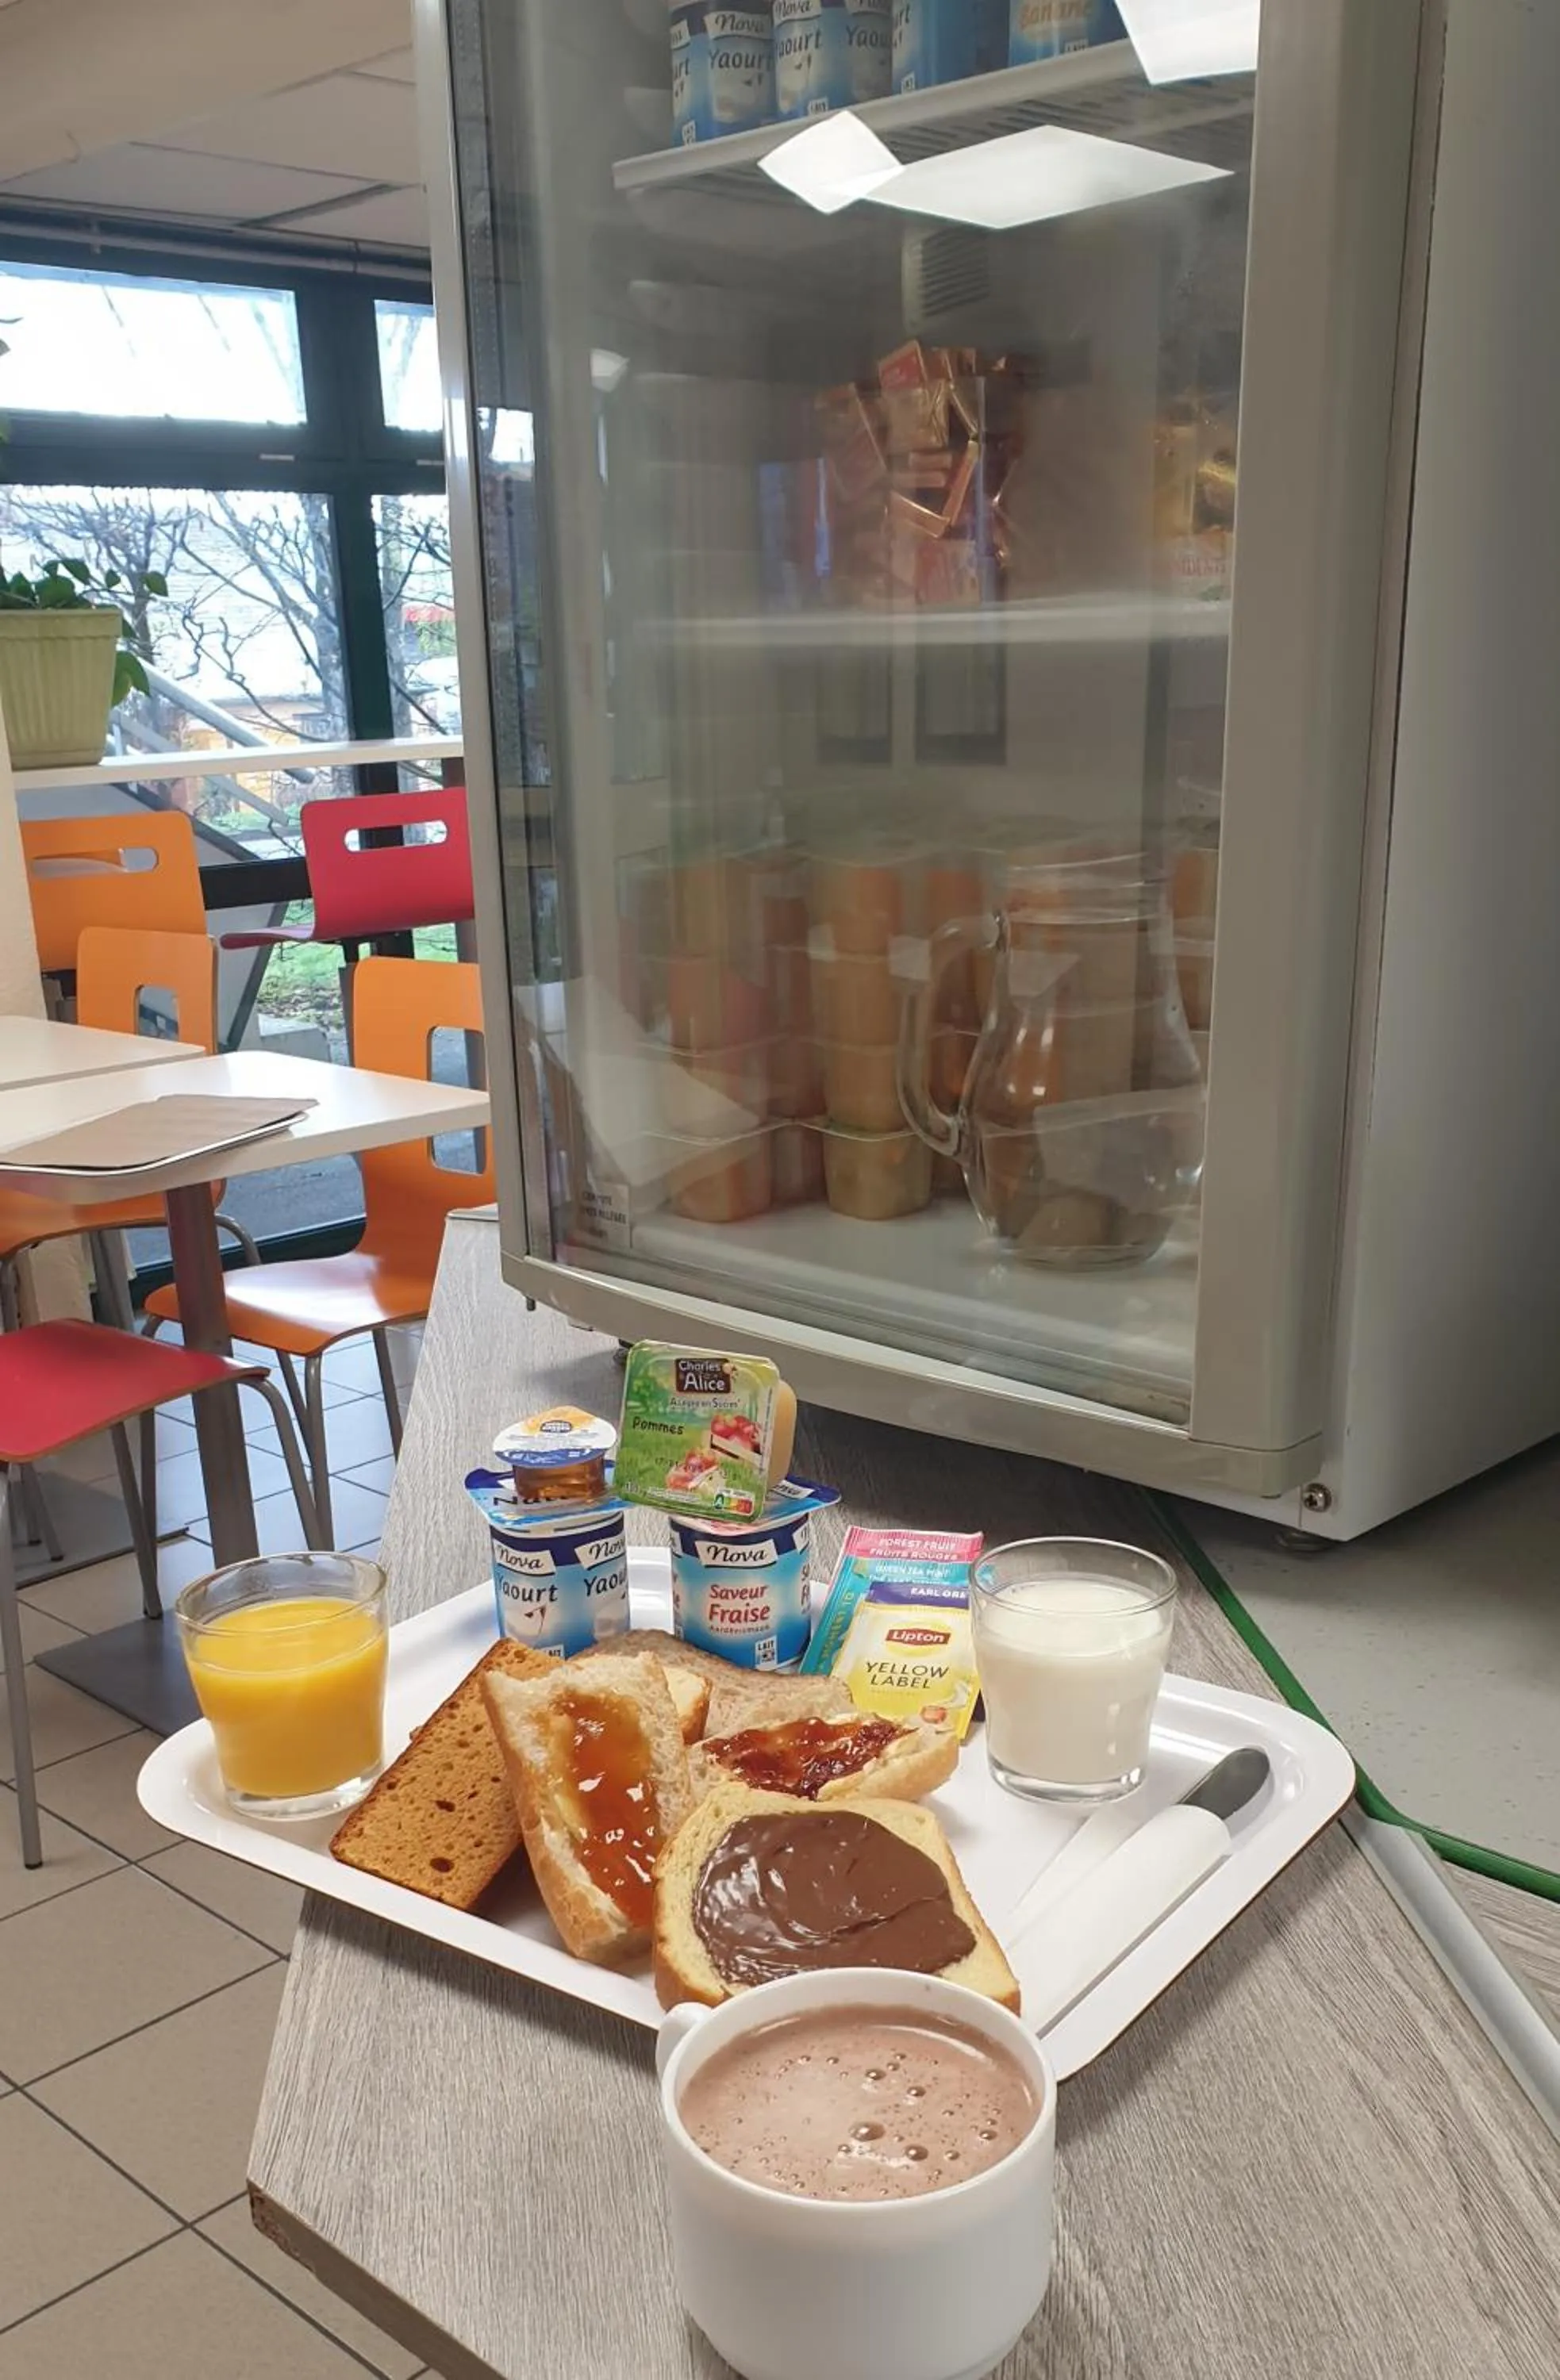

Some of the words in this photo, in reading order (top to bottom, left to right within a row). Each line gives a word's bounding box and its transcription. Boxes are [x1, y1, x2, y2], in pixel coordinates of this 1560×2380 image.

[714, 14, 765, 33] Nova
[775, 29, 822, 59] aourt
[846, 25, 892, 48] Yaou
[678, 1360, 721, 1372] Charles
[683, 1372, 725, 1392] Alice
[498, 1545, 544, 1570] Nova
[588, 1539, 626, 1560] Nov
[707, 1545, 768, 1564] Nova
[496, 1573, 559, 1603] Yaourt
[583, 1568, 628, 1598] Yaou
[709, 1584, 770, 1600] Saveur
[911, 1587, 942, 1598] EARL
[709, 1603, 771, 1624] Fraise
[757, 1640, 775, 1651] LAIT
[891, 1630, 946, 1643] Lipton
[866, 1661, 950, 1679] YELLOW
[870, 1674, 931, 1689] LABEL
